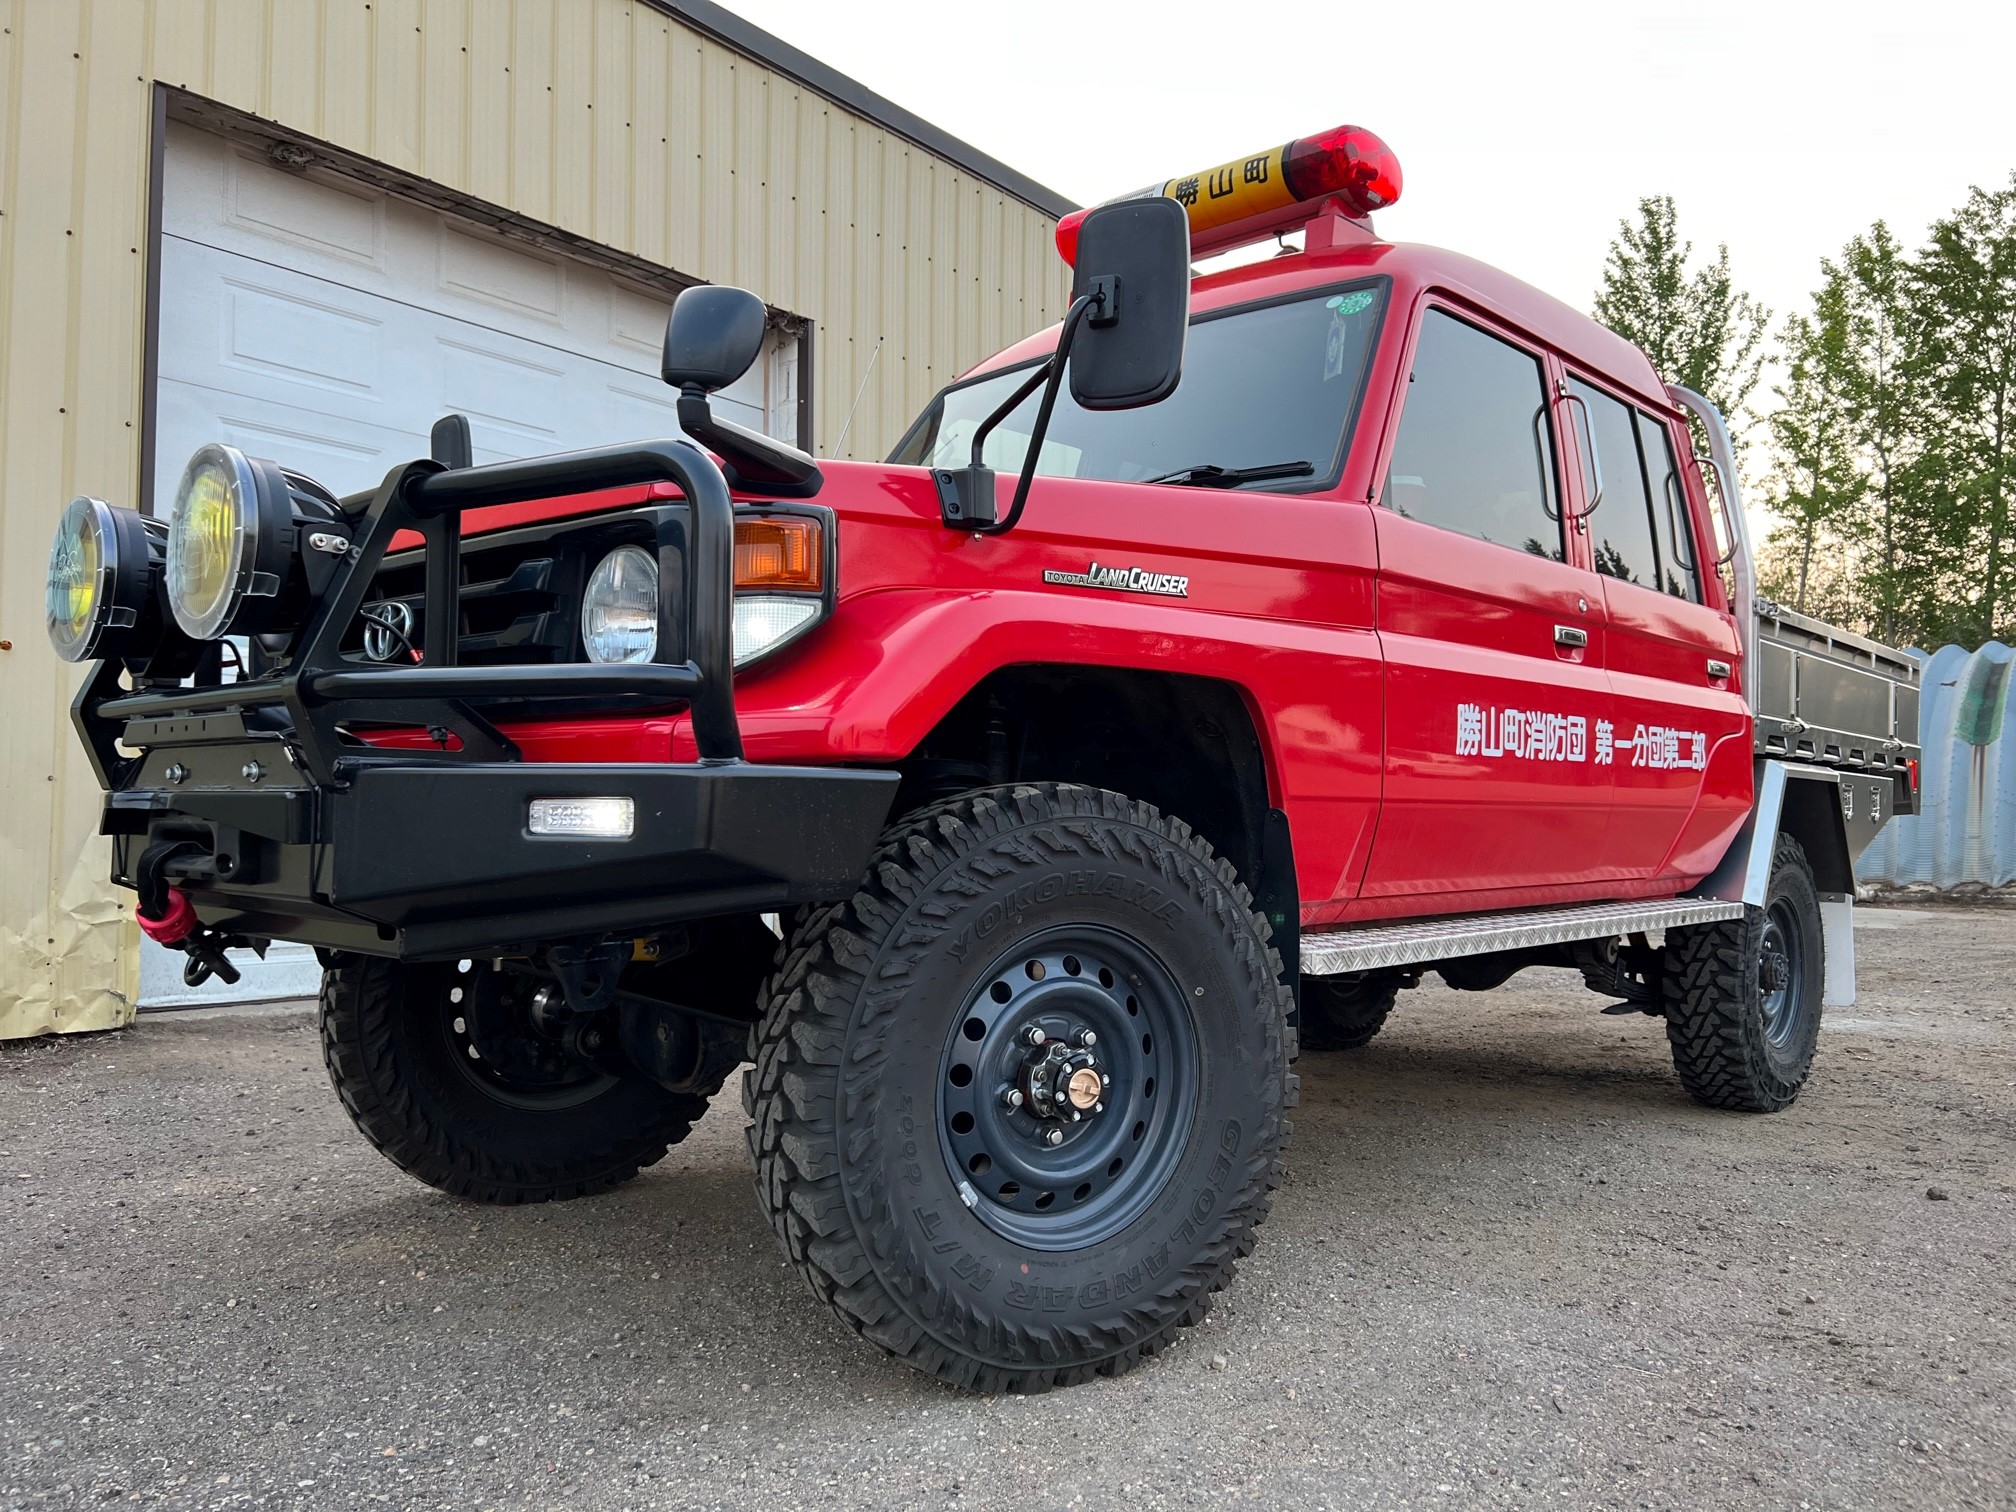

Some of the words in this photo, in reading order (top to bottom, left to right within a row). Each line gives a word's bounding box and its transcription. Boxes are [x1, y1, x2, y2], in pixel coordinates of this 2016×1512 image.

[1175, 154, 1270, 208] 勝山町
[1046, 571, 1086, 585] TOYOTA
[1456, 703, 1587, 763] 勝山町消防団
[1593, 718, 1707, 772] 第一分団第二部
[946, 869, 1187, 964] YOKOHAMA
[1004, 1118, 1243, 1313] GEOLANDAR
